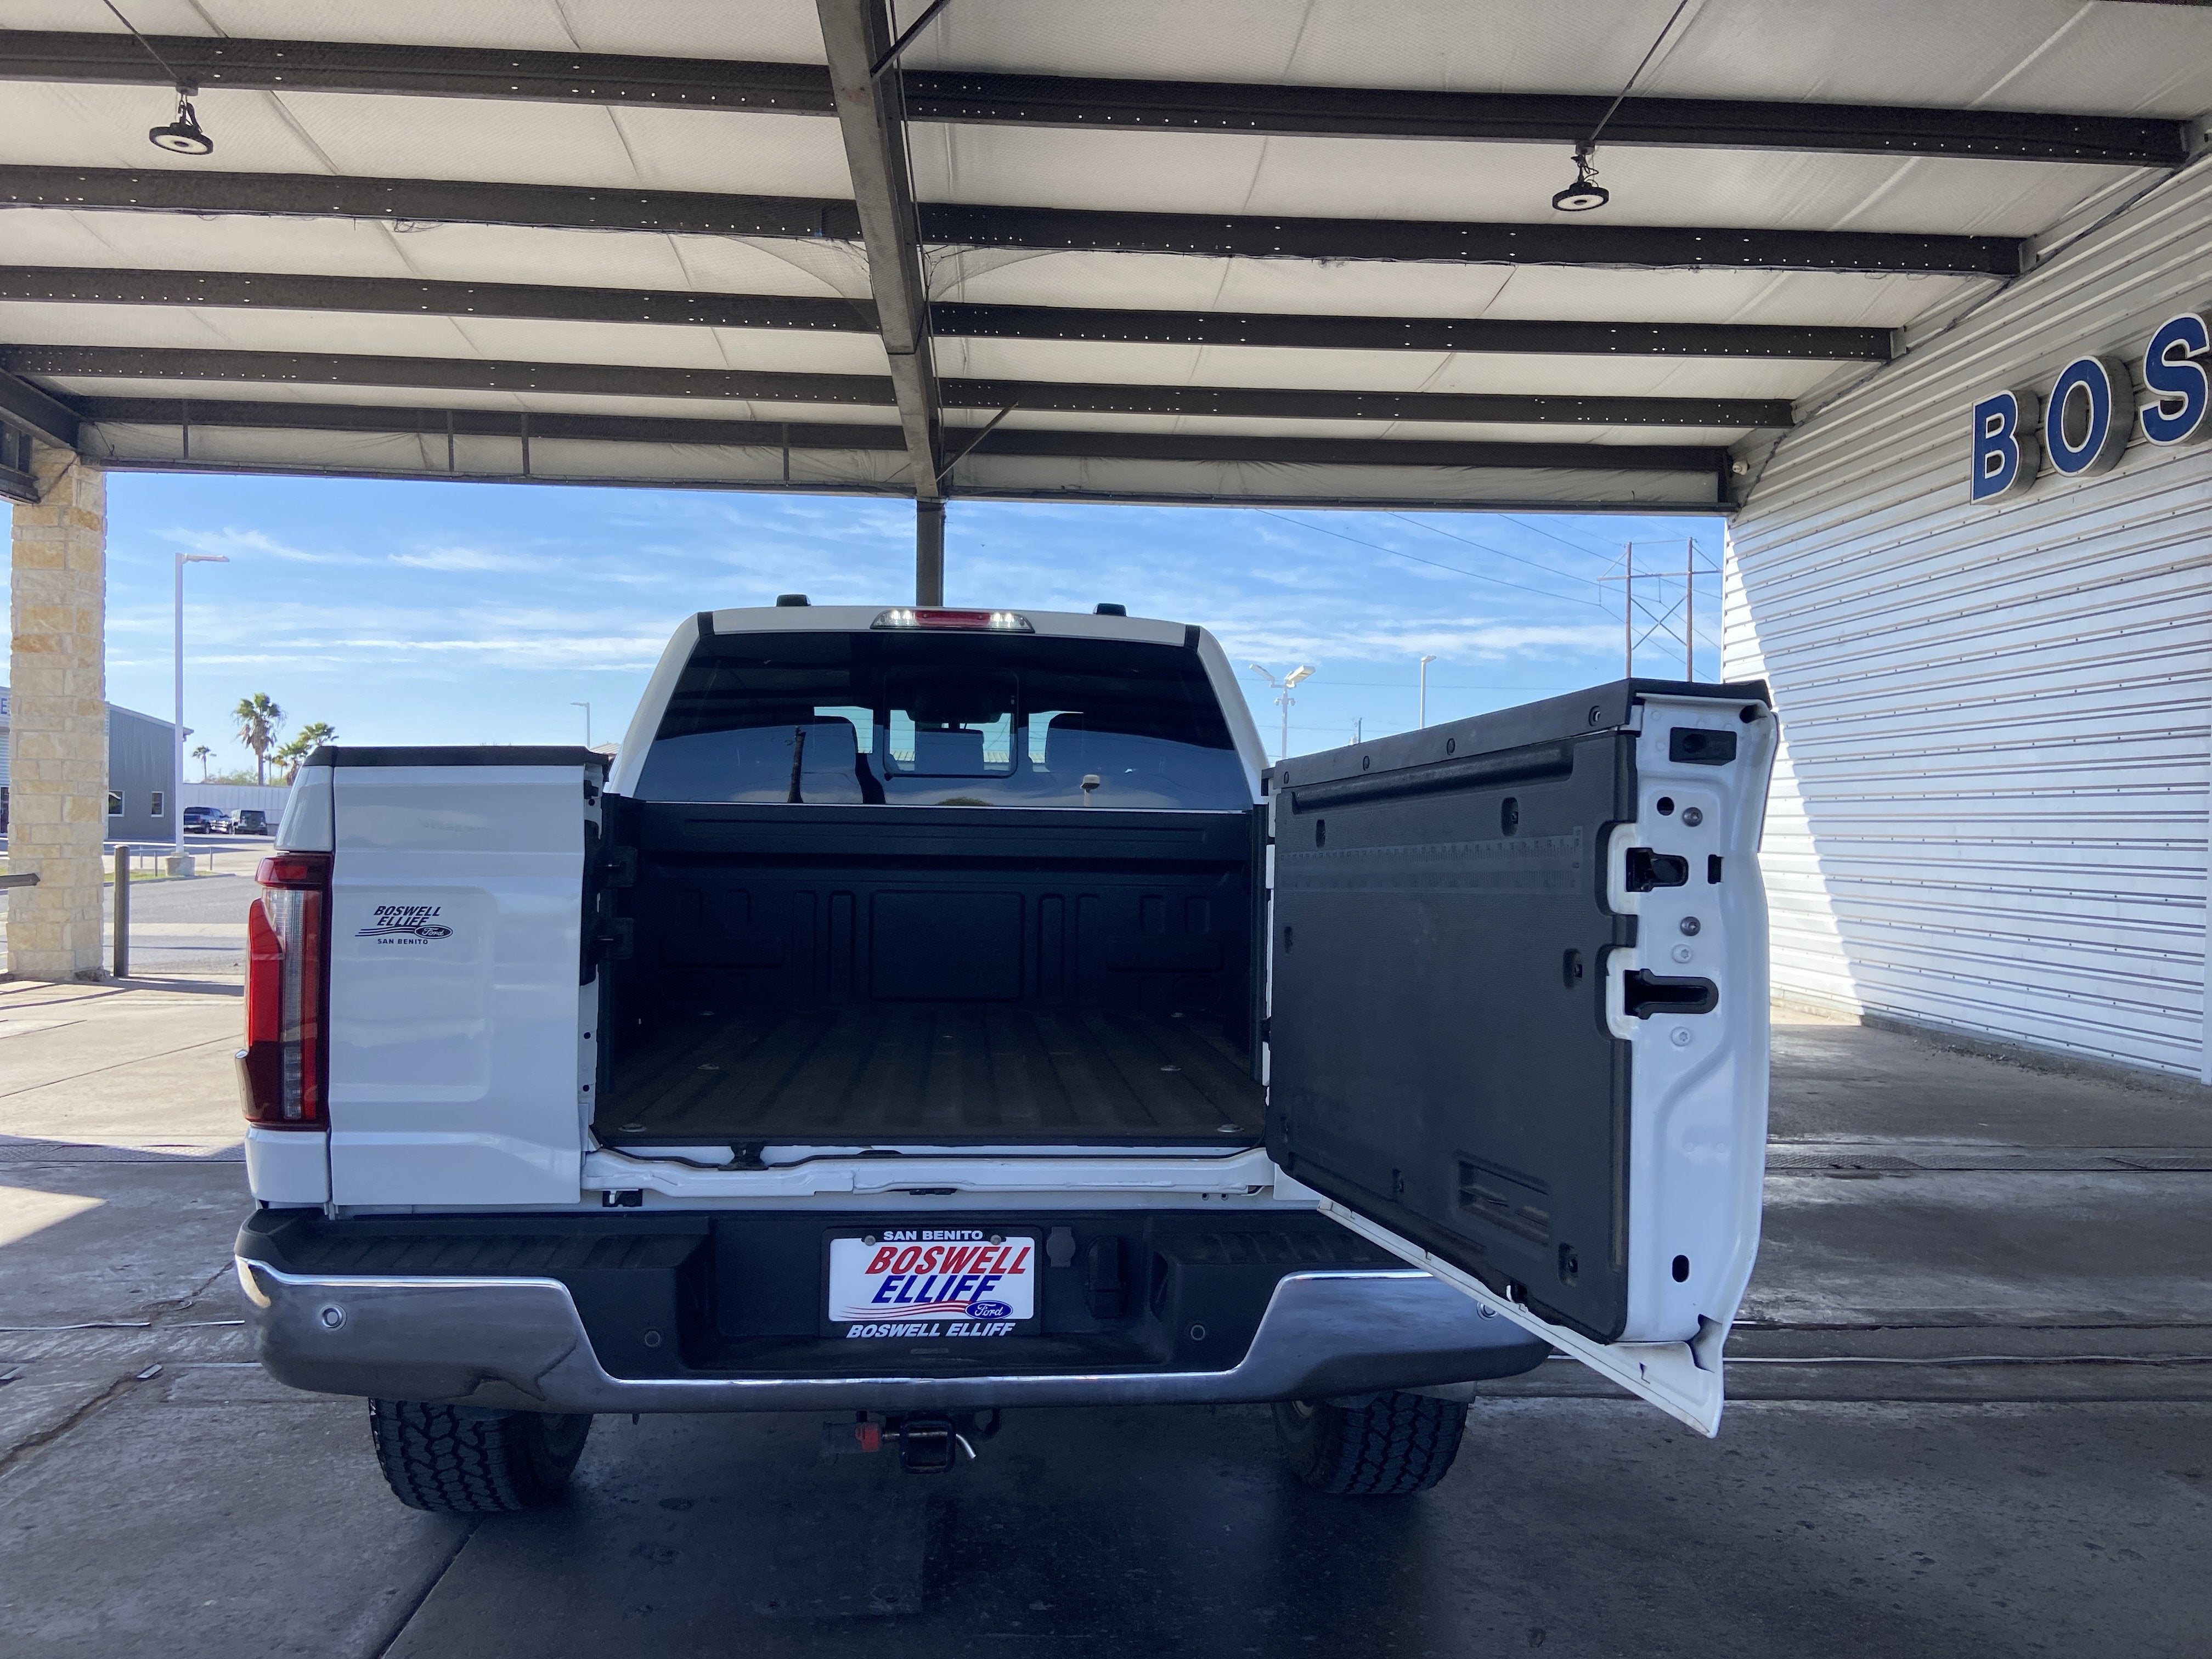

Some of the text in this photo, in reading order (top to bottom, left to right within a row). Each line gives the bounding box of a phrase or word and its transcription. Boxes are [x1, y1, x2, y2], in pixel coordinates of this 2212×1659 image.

[1970, 312, 2210, 505] BOS
[373, 906, 441, 916] BOSWELL
[377, 916, 430, 926] ELLIFF
[420, 927, 447, 938] Ford
[883, 1231, 984, 1240] SAN BENITO
[865, 1246, 1031, 1274] BOSWELL
[871, 1274, 1003, 1304] ELLIFF
[973, 1302, 1005, 1318] Ford
[846, 1322, 1016, 1339] BOSWELL ELLIFF
